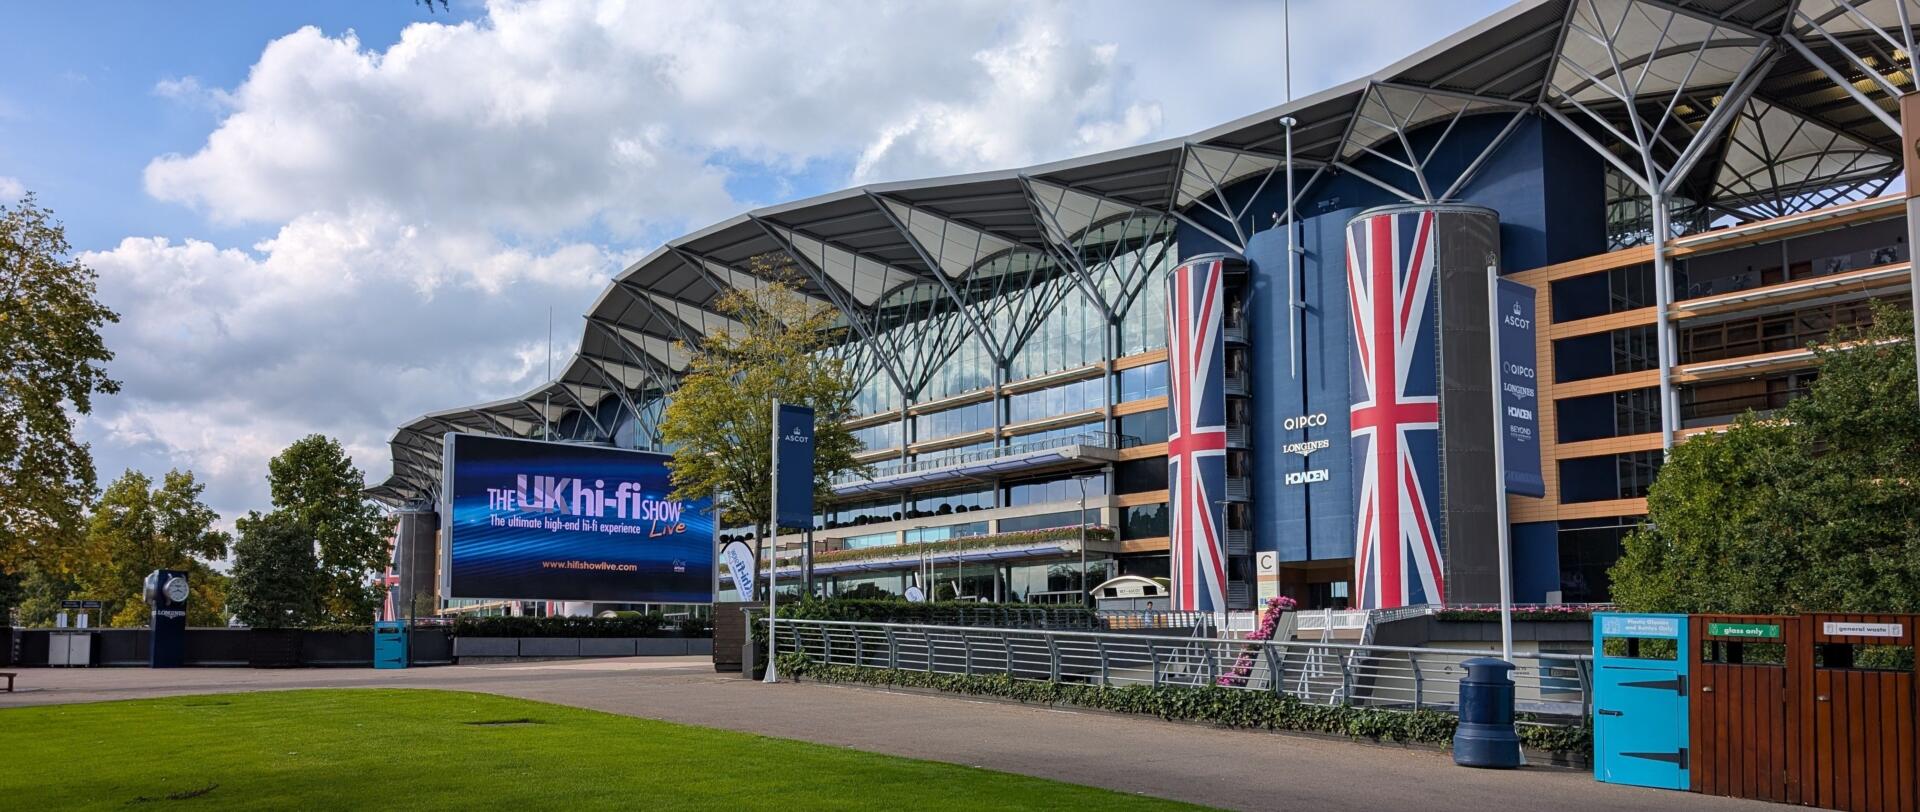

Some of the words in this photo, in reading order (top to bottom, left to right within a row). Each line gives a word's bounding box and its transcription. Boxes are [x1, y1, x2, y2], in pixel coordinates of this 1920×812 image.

[1504, 314, 1530, 330] ASCOT
[1511, 364, 1534, 378] QIPCO
[1503, 382, 1535, 397] LONGINES
[1284, 413, 1327, 430] QIPCO
[1510, 424, 1531, 436] BEYOND
[785, 434, 808, 443] ASCOT
[1282, 440, 1329, 453] LONGINES
[487, 488, 516, 511] THE
[642, 499, 681, 523] SHOW
[490, 513, 505, 527] The
[508, 514, 542, 529] ultimate
[544, 516, 580, 532] high-end
[582, 519, 598, 532] hi-fi
[600, 522, 641, 535] experience
[649, 518, 687, 538] Live
[542, 560, 638, 572] www.hifishowlive.com
[1260, 554, 1273, 570] C
[1723, 626, 1744, 635] glass
[1745, 627, 1764, 637] only
